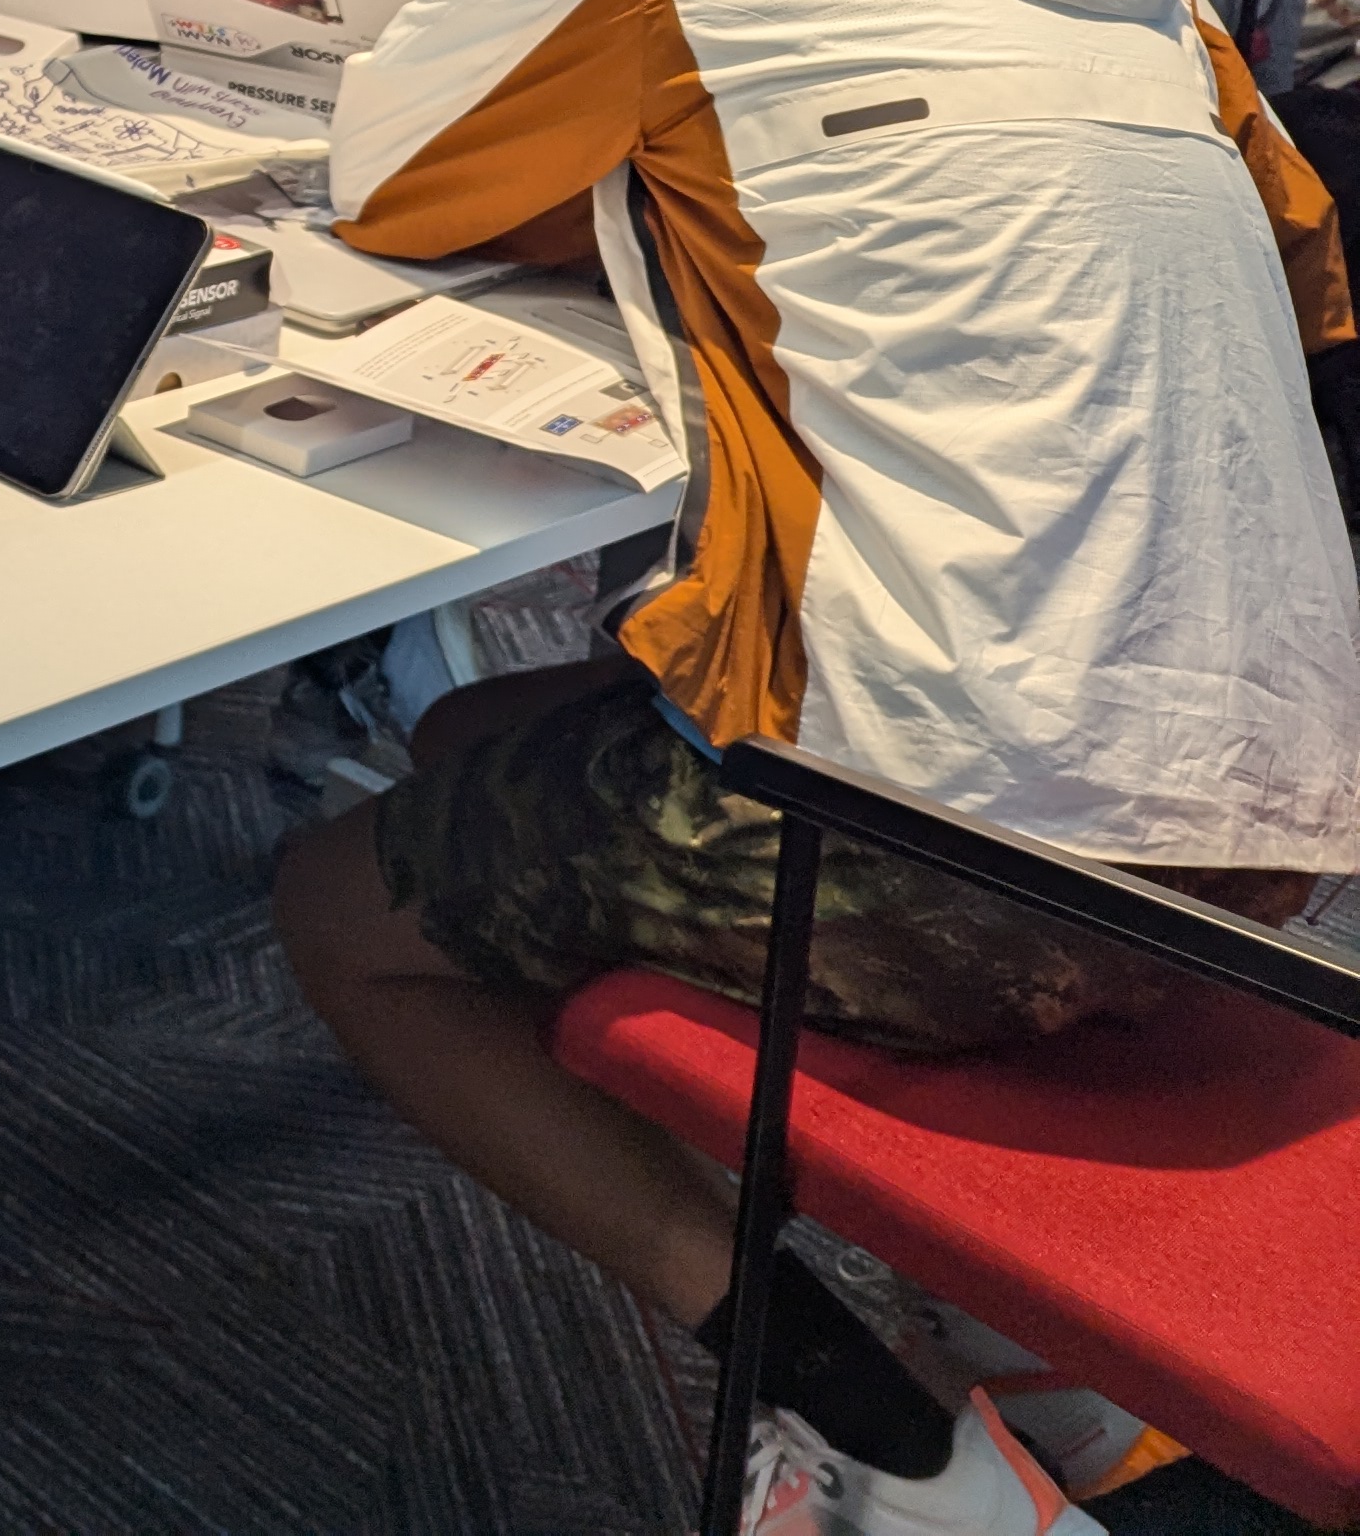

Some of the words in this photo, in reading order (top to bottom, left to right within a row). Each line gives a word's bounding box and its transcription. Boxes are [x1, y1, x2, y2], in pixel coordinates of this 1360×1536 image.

[113, 44, 172, 86] Materi
[289, 45, 346, 65] NSOR
[228, 81, 306, 109] PRESSURE
